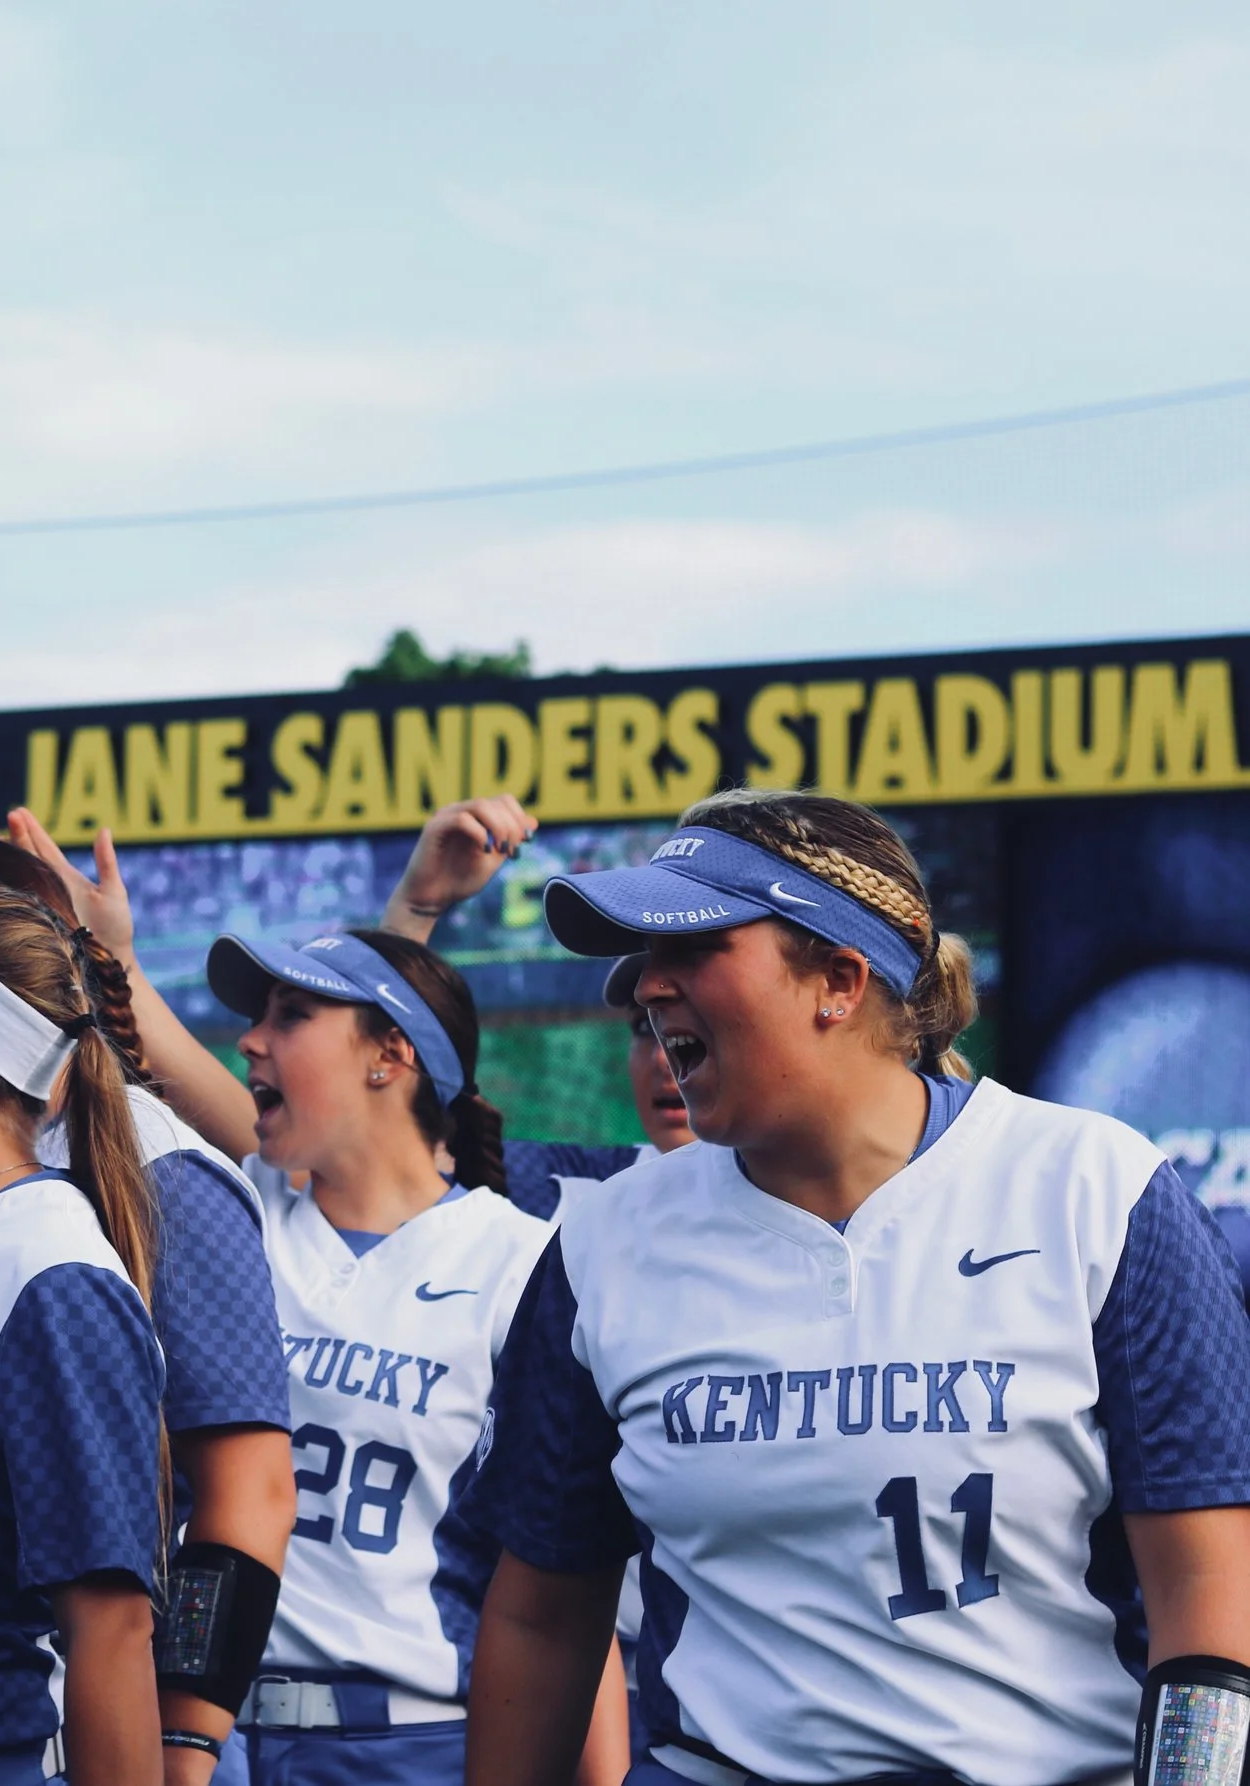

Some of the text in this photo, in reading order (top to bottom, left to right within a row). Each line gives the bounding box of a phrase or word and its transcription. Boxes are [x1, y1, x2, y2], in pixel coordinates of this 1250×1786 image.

[25, 658, 1238, 838] JANE SANDERS STADIUM
[642, 905, 730, 924] SOFTBALL
[283, 966, 350, 992] SOFTBALL
[662, 1360, 1016, 1444] KENTUCKY
[291, 1422, 418, 1555] 28
[875, 1473, 1000, 1620] 11
